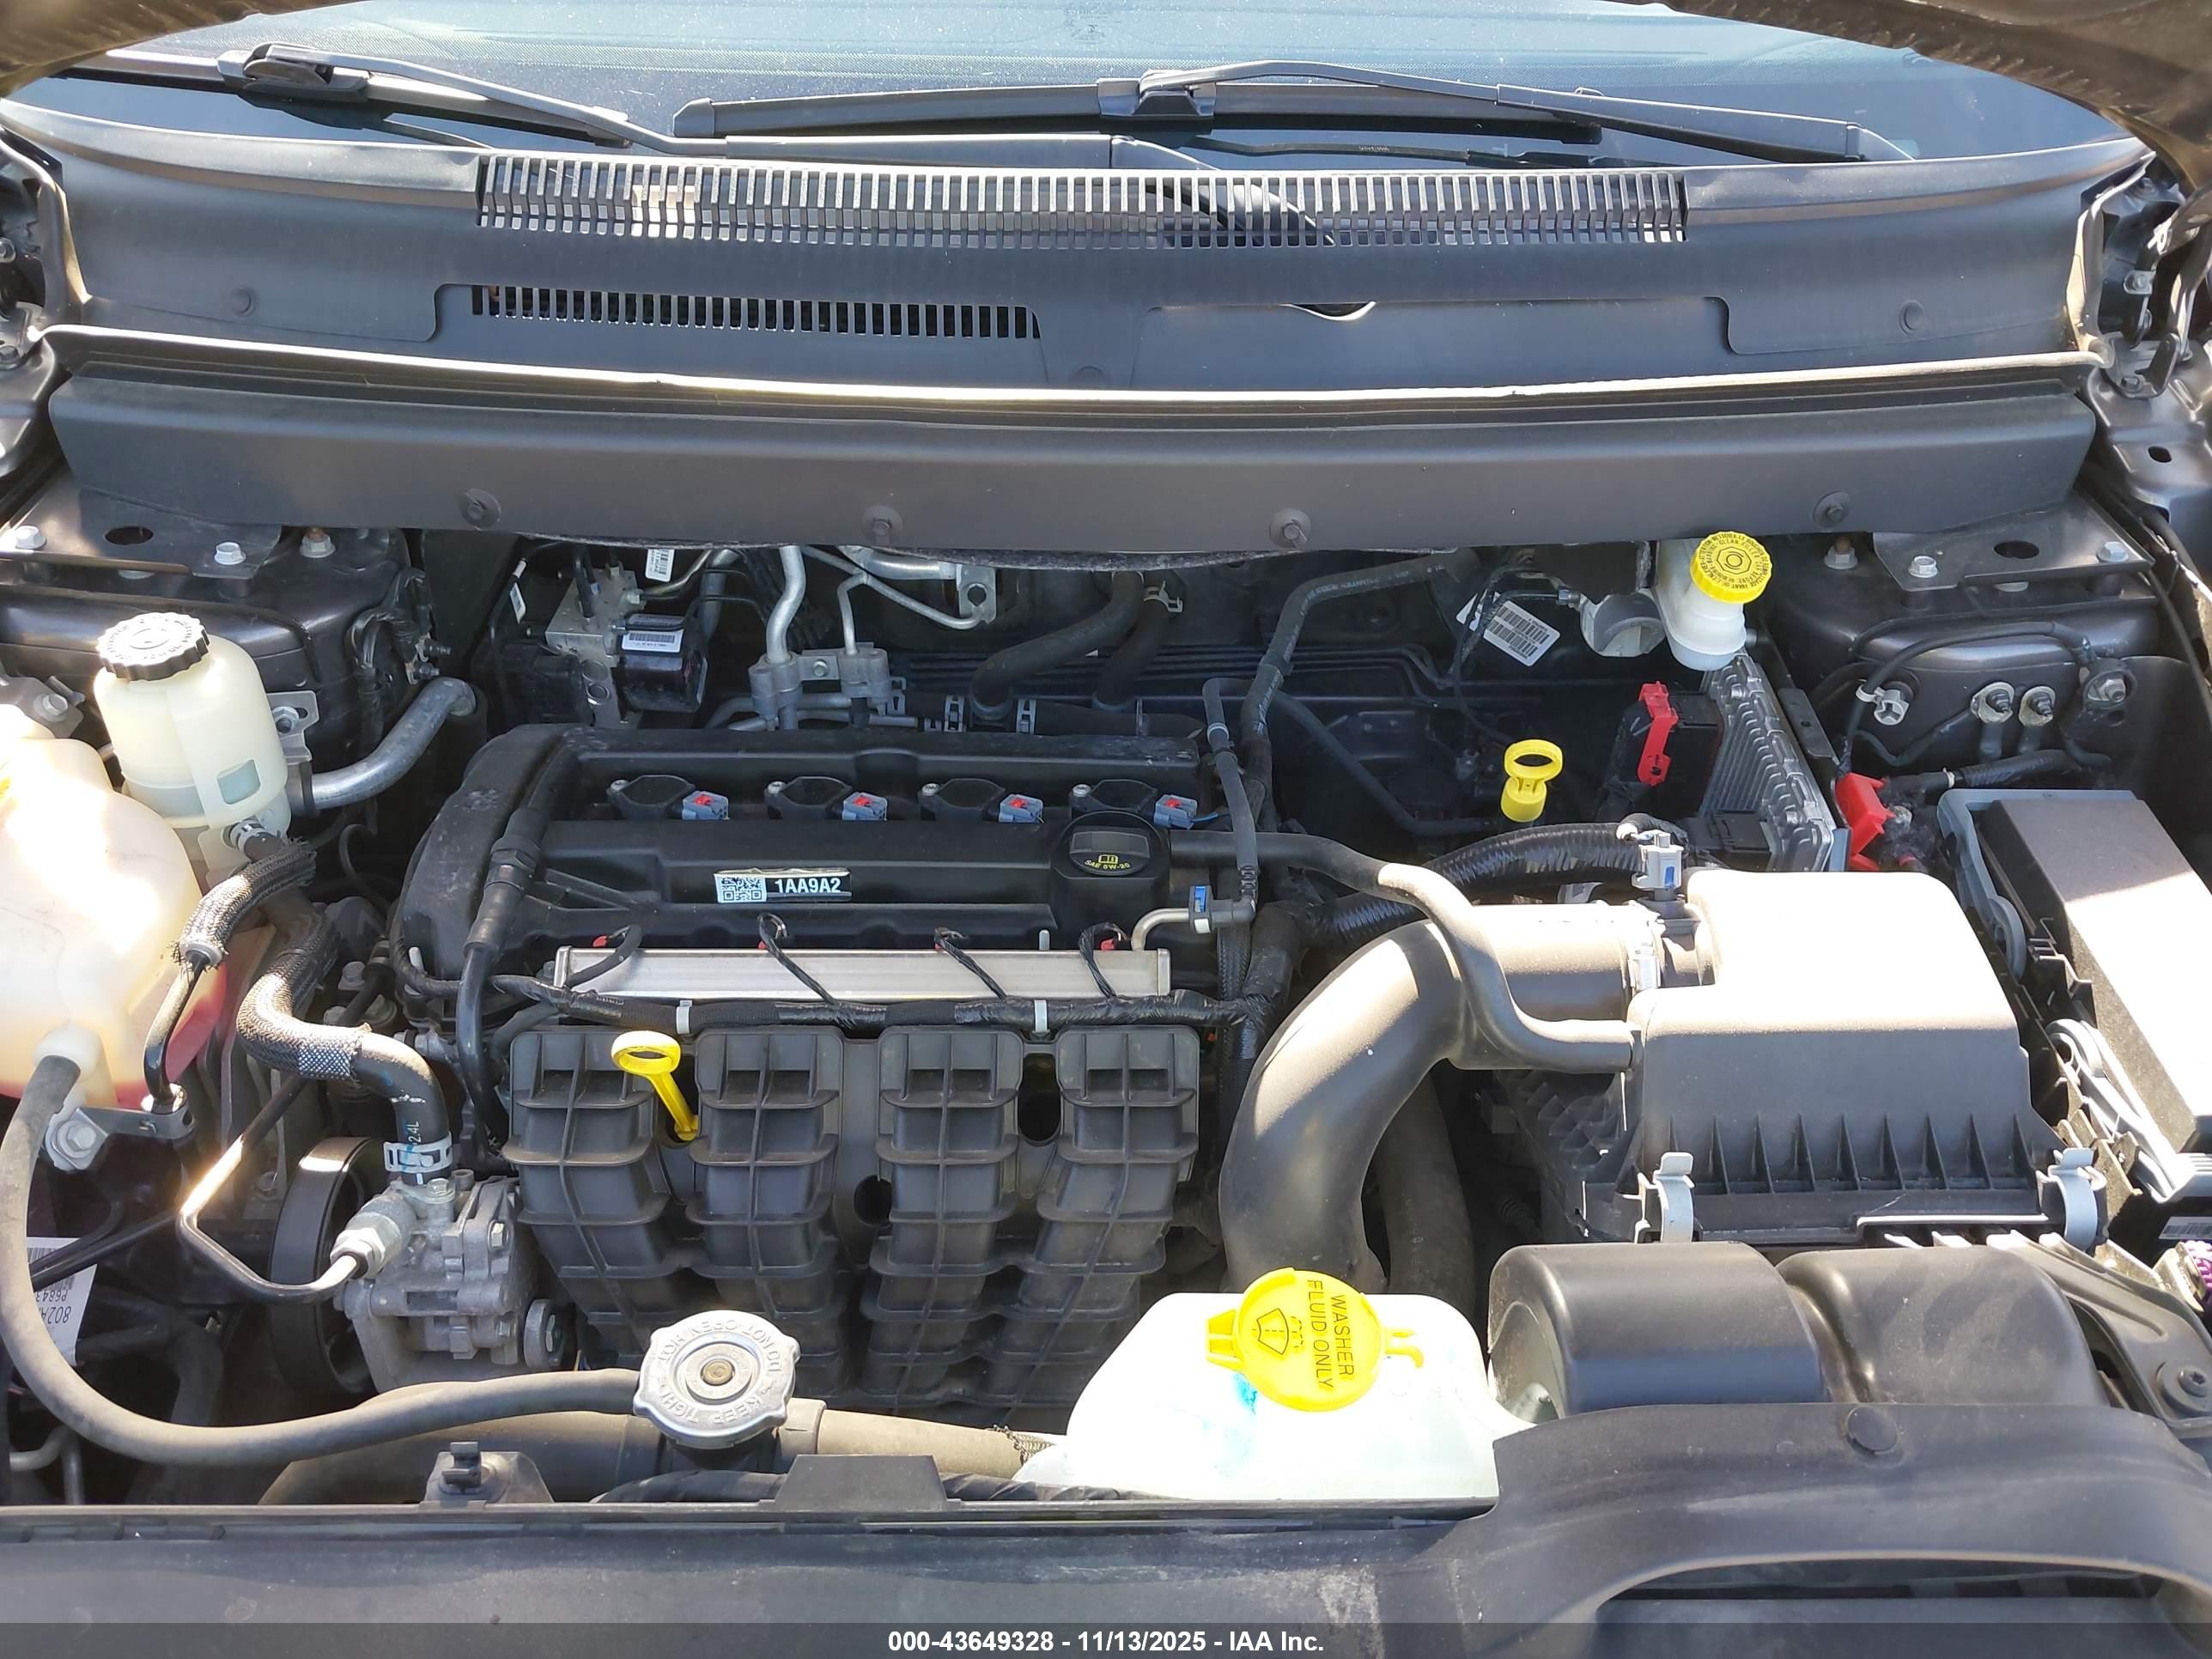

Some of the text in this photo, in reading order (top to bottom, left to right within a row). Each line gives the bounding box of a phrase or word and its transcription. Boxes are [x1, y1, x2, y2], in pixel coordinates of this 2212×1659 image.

[1085, 860, 1102, 869] SAE
[775, 878, 842, 894] 1AA9A2
[742, 1325, 775, 1349] NOT
[1308, 1279, 1334, 1389] FLUID ONLY
[1331, 1294, 1354, 1376] WASHER
[711, 1394, 765, 1425] KEEP
